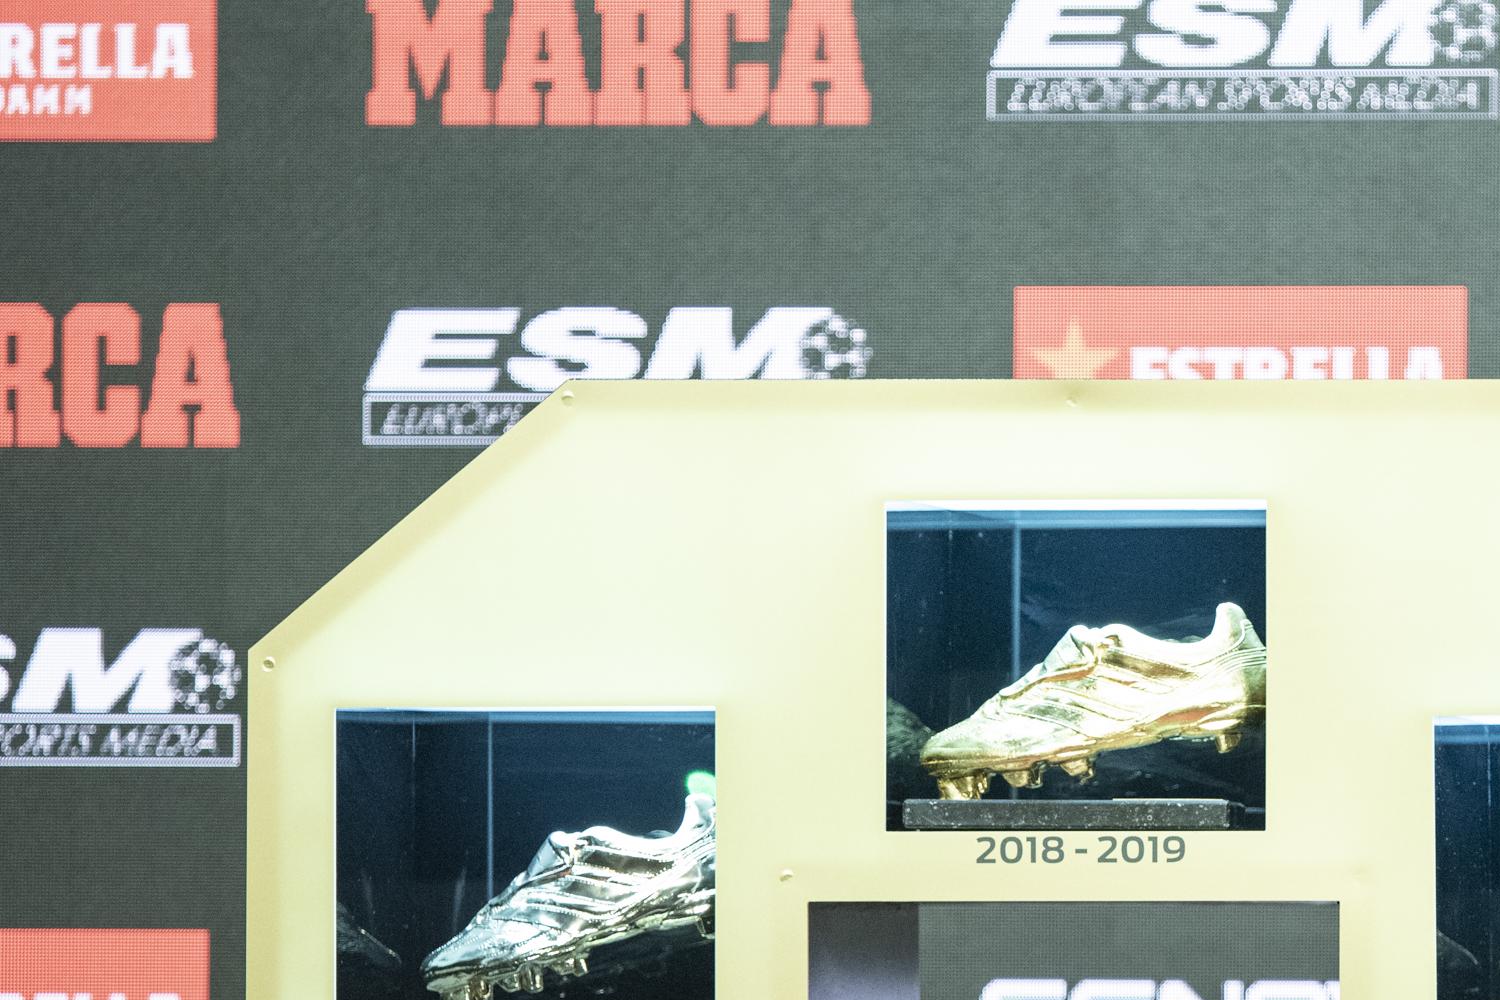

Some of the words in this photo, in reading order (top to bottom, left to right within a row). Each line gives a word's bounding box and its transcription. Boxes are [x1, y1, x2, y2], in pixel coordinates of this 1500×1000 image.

[365, 0, 872, 126] MARCA
[989, 0, 1442, 67] ESM
[364, 307, 836, 391] ESM
